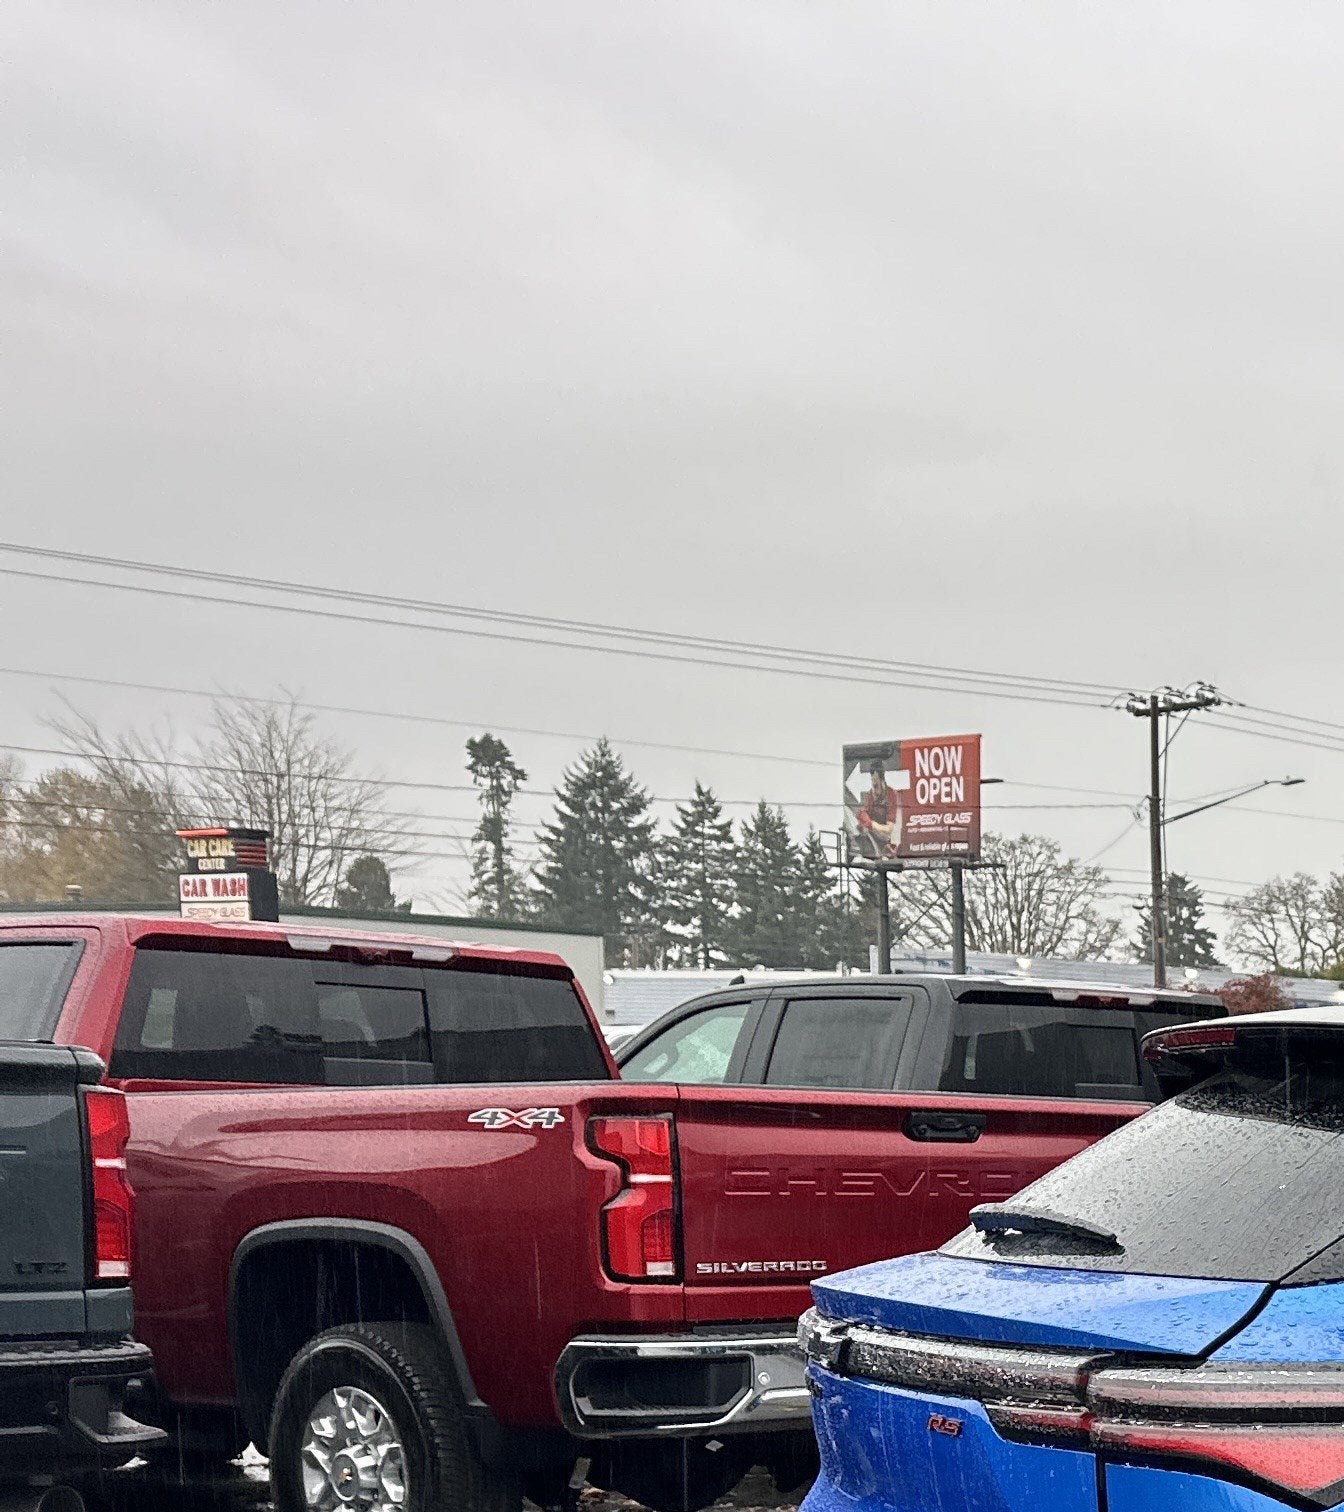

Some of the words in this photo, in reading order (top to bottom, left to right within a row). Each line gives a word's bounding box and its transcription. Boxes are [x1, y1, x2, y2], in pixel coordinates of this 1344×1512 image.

[914, 744, 963, 778] NOW
[916, 776, 964, 804] OPEN
[905, 813, 943, 827] SPEEDY
[943, 811, 974, 825] GLASS
[187, 839, 207, 858] CAR
[208, 838, 236, 857] CARE
[198, 858, 226, 870] CENTER
[181, 878, 208, 897] CAR
[211, 877, 247, 896] WASH
[219, 906, 246, 918] GLASS
[724, 1167, 1040, 1197] CHEVRO
[13, 1261, 68, 1275] LTZ
[696, 1260, 828, 1275] SILVERADO
[927, 1413, 961, 1436] RS
